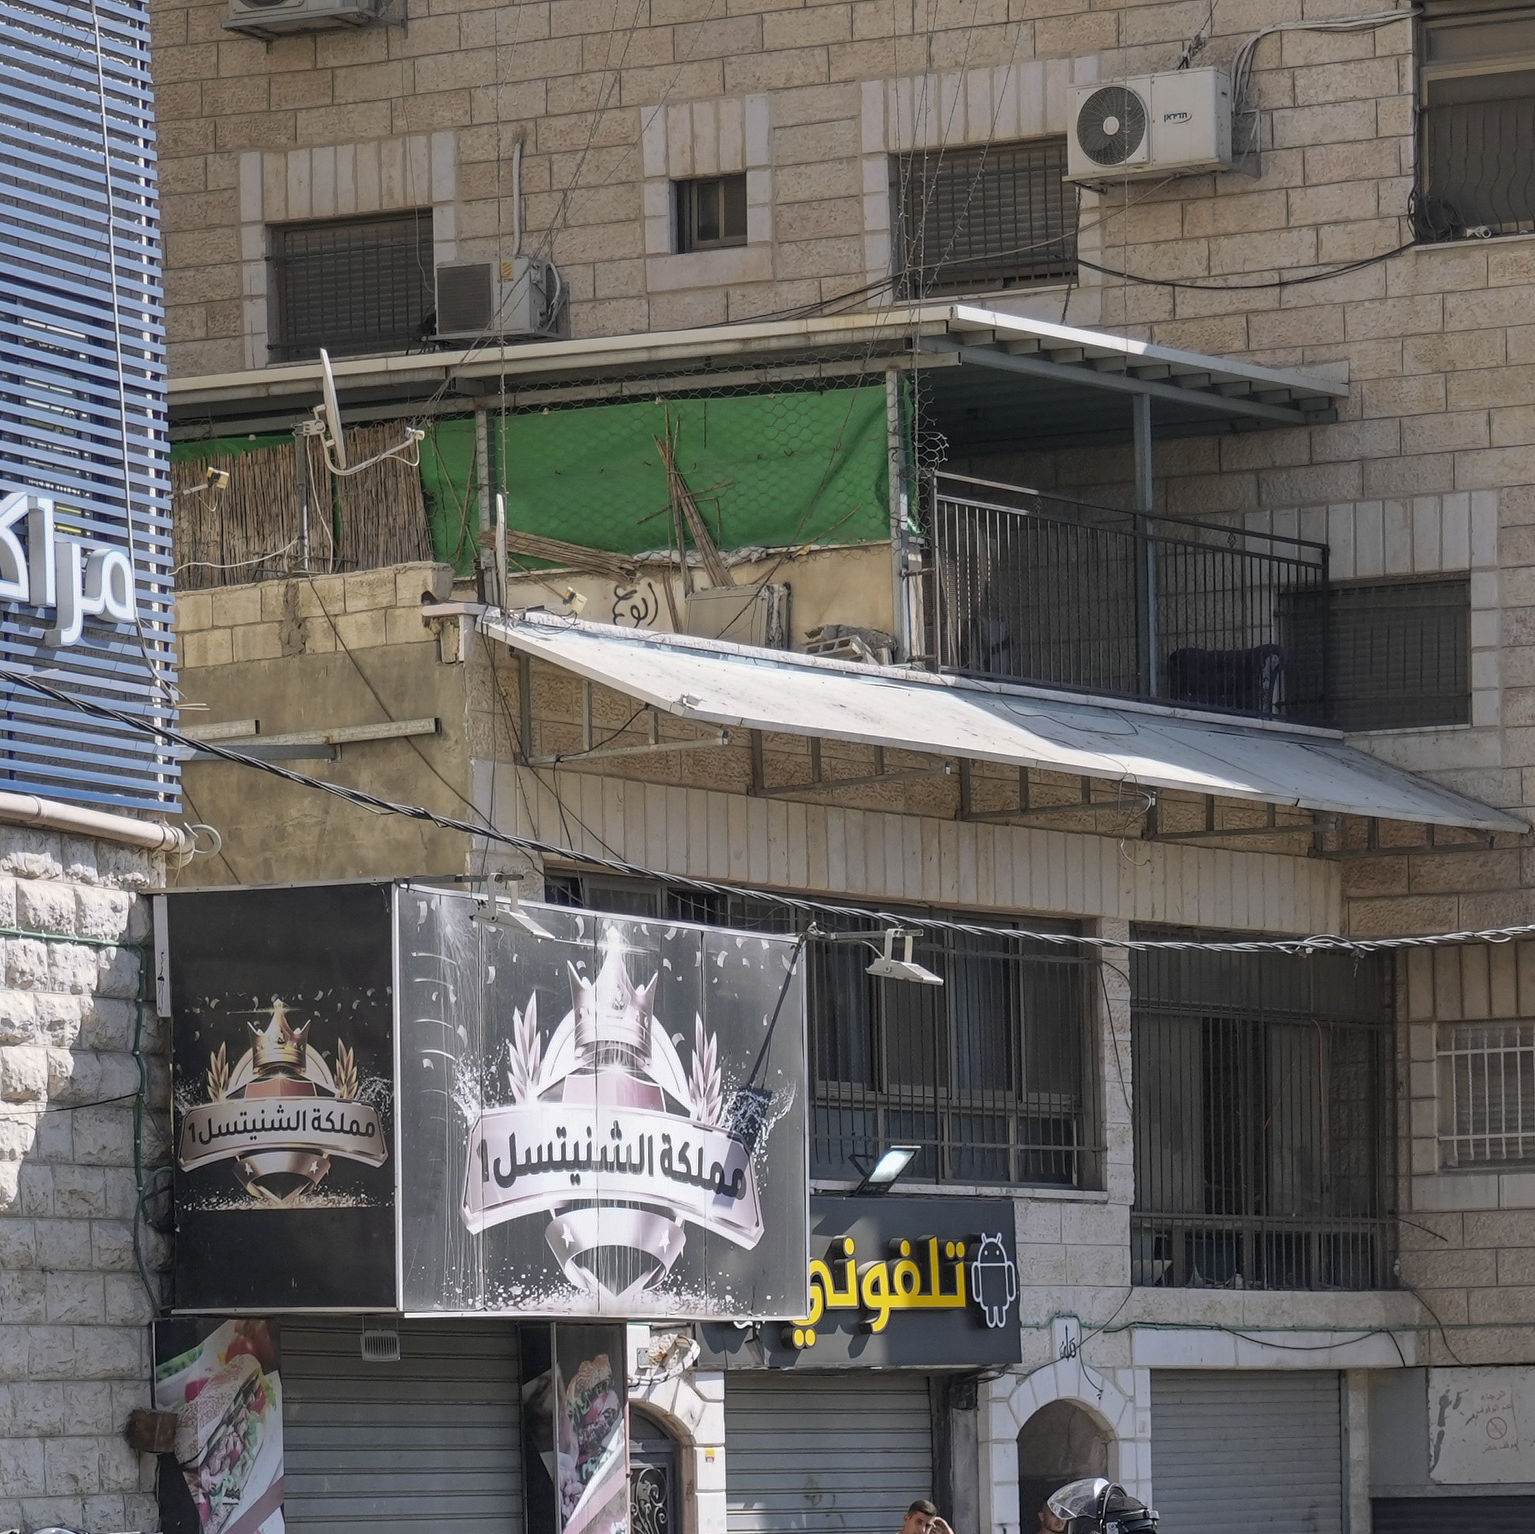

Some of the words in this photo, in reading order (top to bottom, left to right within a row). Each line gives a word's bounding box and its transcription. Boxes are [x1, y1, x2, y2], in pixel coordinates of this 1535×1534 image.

[1163, 111, 1188, 123] תדיראן
[311, 1107, 376, 1139] مملكة
[659, 1132, 747, 1201] مملكة
[788, 1235, 967, 1350] تلفوني
